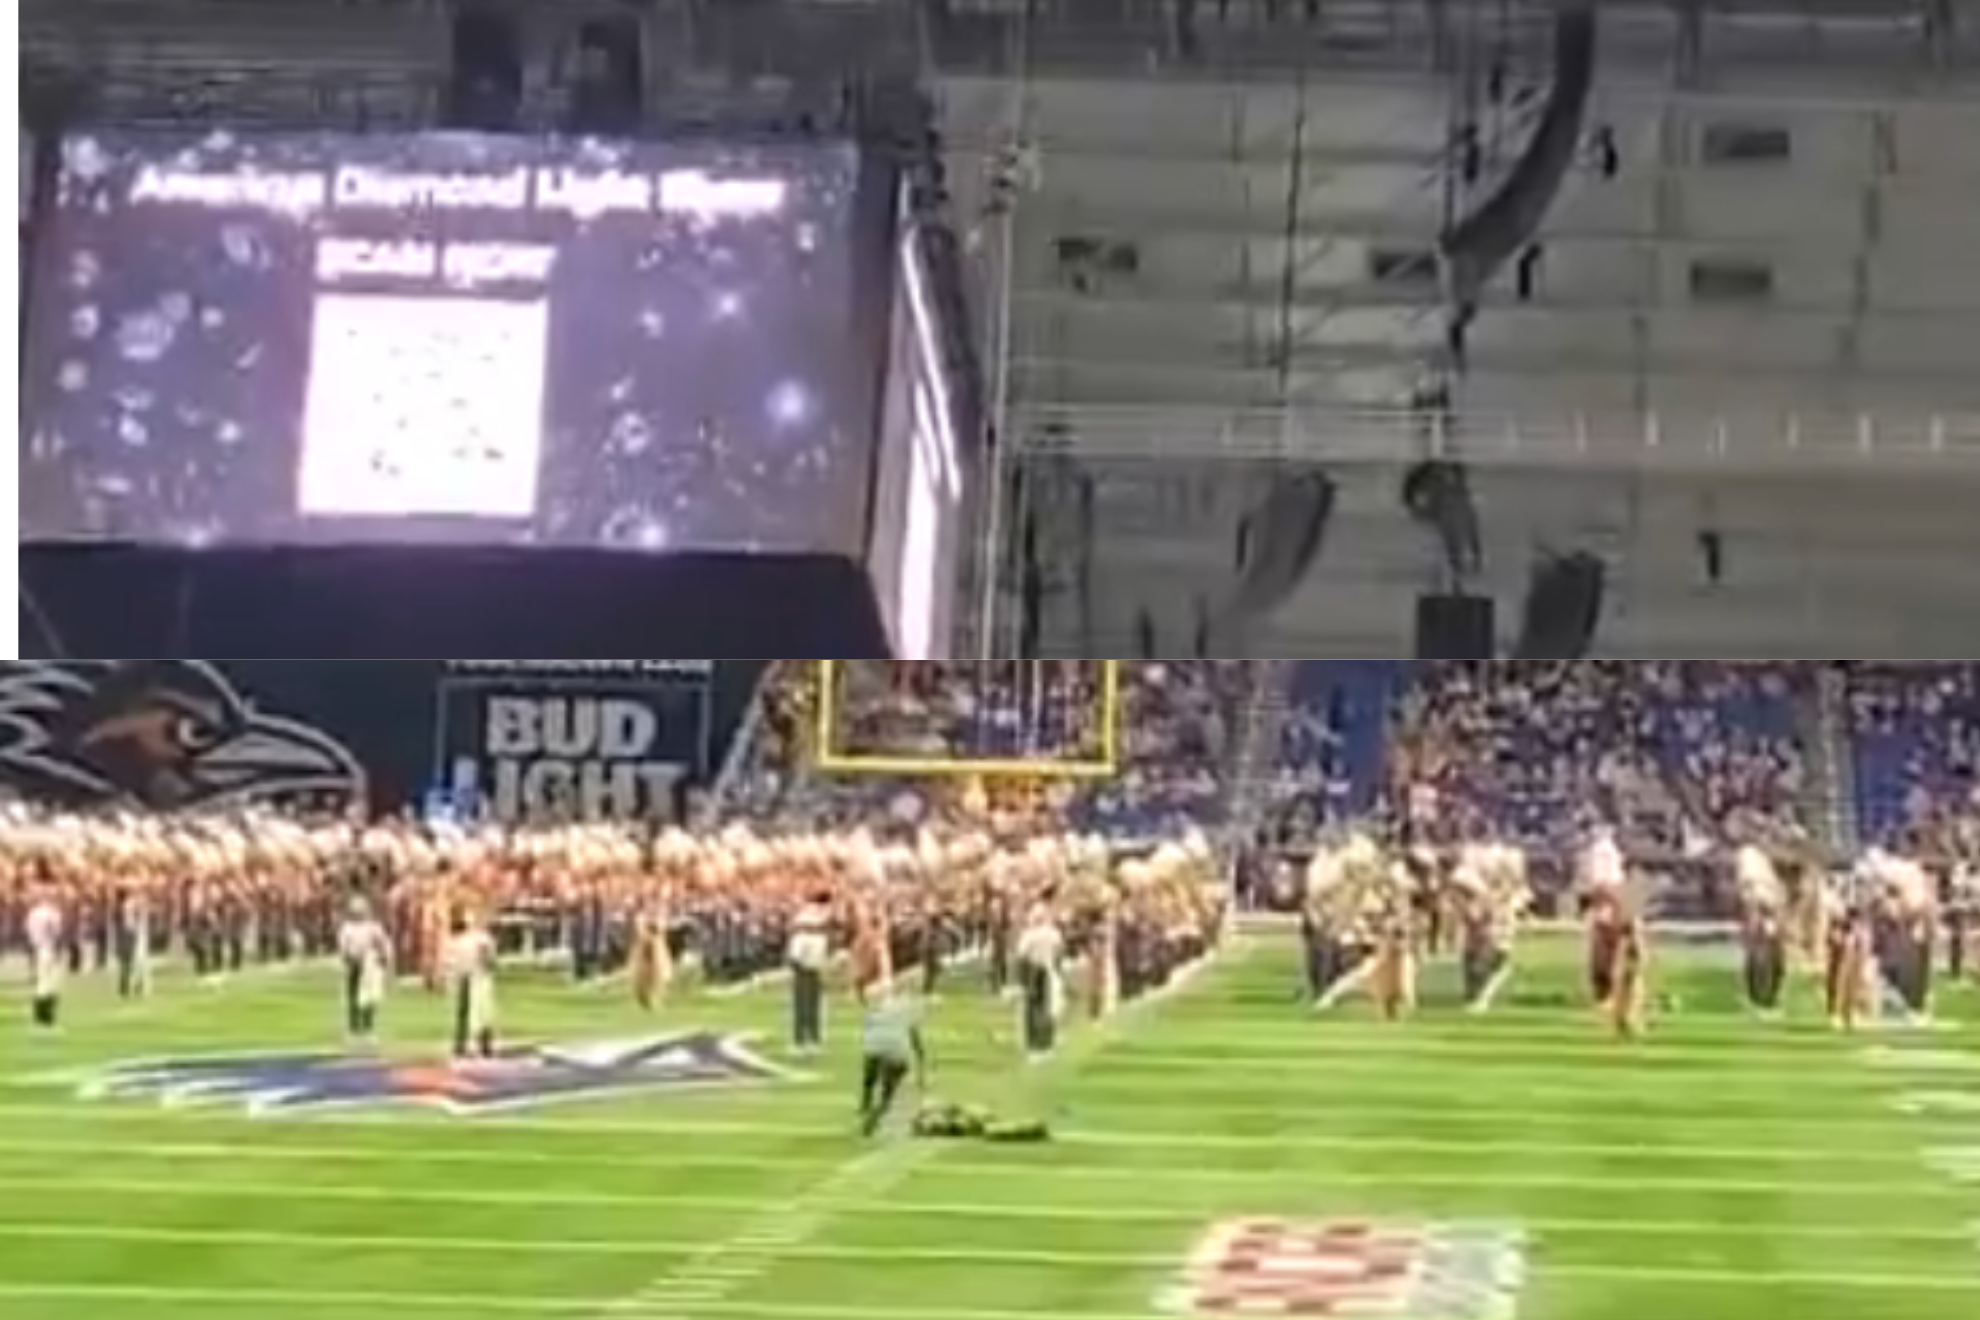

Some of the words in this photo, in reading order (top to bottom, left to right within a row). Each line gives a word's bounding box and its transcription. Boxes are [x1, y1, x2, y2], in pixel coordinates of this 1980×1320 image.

[333, 165, 528, 207] Diamond
[536, 168, 651, 219] Light
[314, 237, 435, 281] SCAN
[442, 241, 558, 287] NOW
[486, 696, 656, 757] BUD
